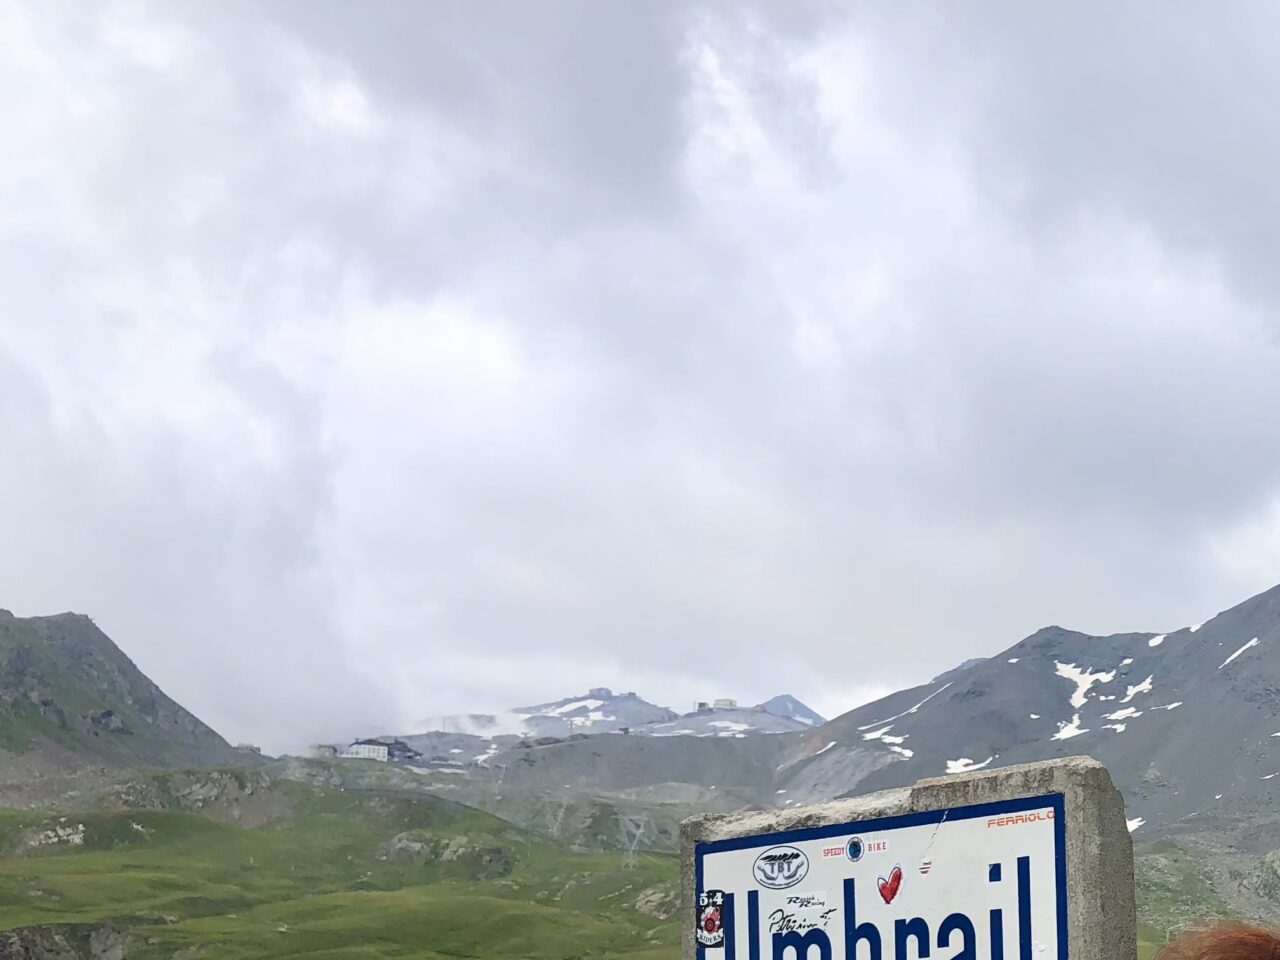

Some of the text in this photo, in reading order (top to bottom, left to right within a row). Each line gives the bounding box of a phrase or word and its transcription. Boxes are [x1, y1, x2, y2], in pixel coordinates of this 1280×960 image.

[823, 842, 886, 857] SPEEDY BIKE
[769, 860, 792, 874] TBT
